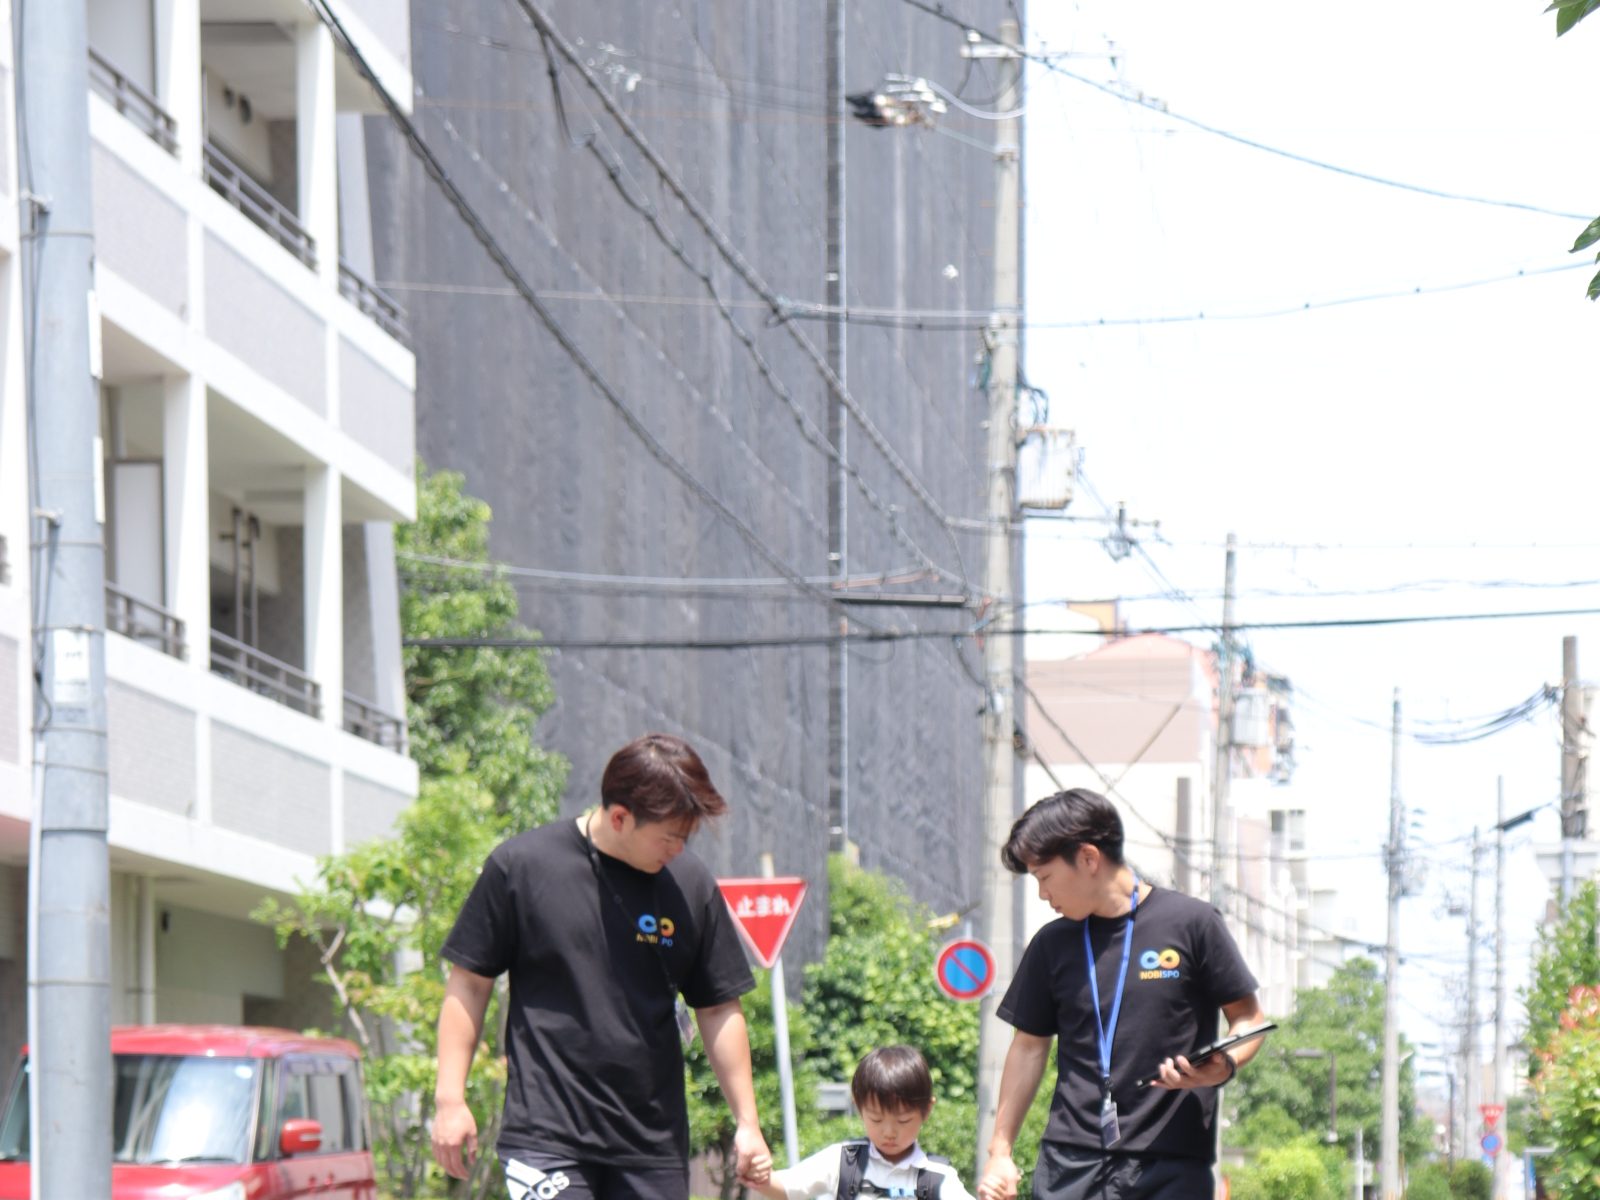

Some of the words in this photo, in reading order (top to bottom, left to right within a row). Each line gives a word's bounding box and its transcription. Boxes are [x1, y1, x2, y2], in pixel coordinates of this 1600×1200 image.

[736, 894, 793, 918] 止まれ
[1140, 969, 1180, 980] NOBISPO
